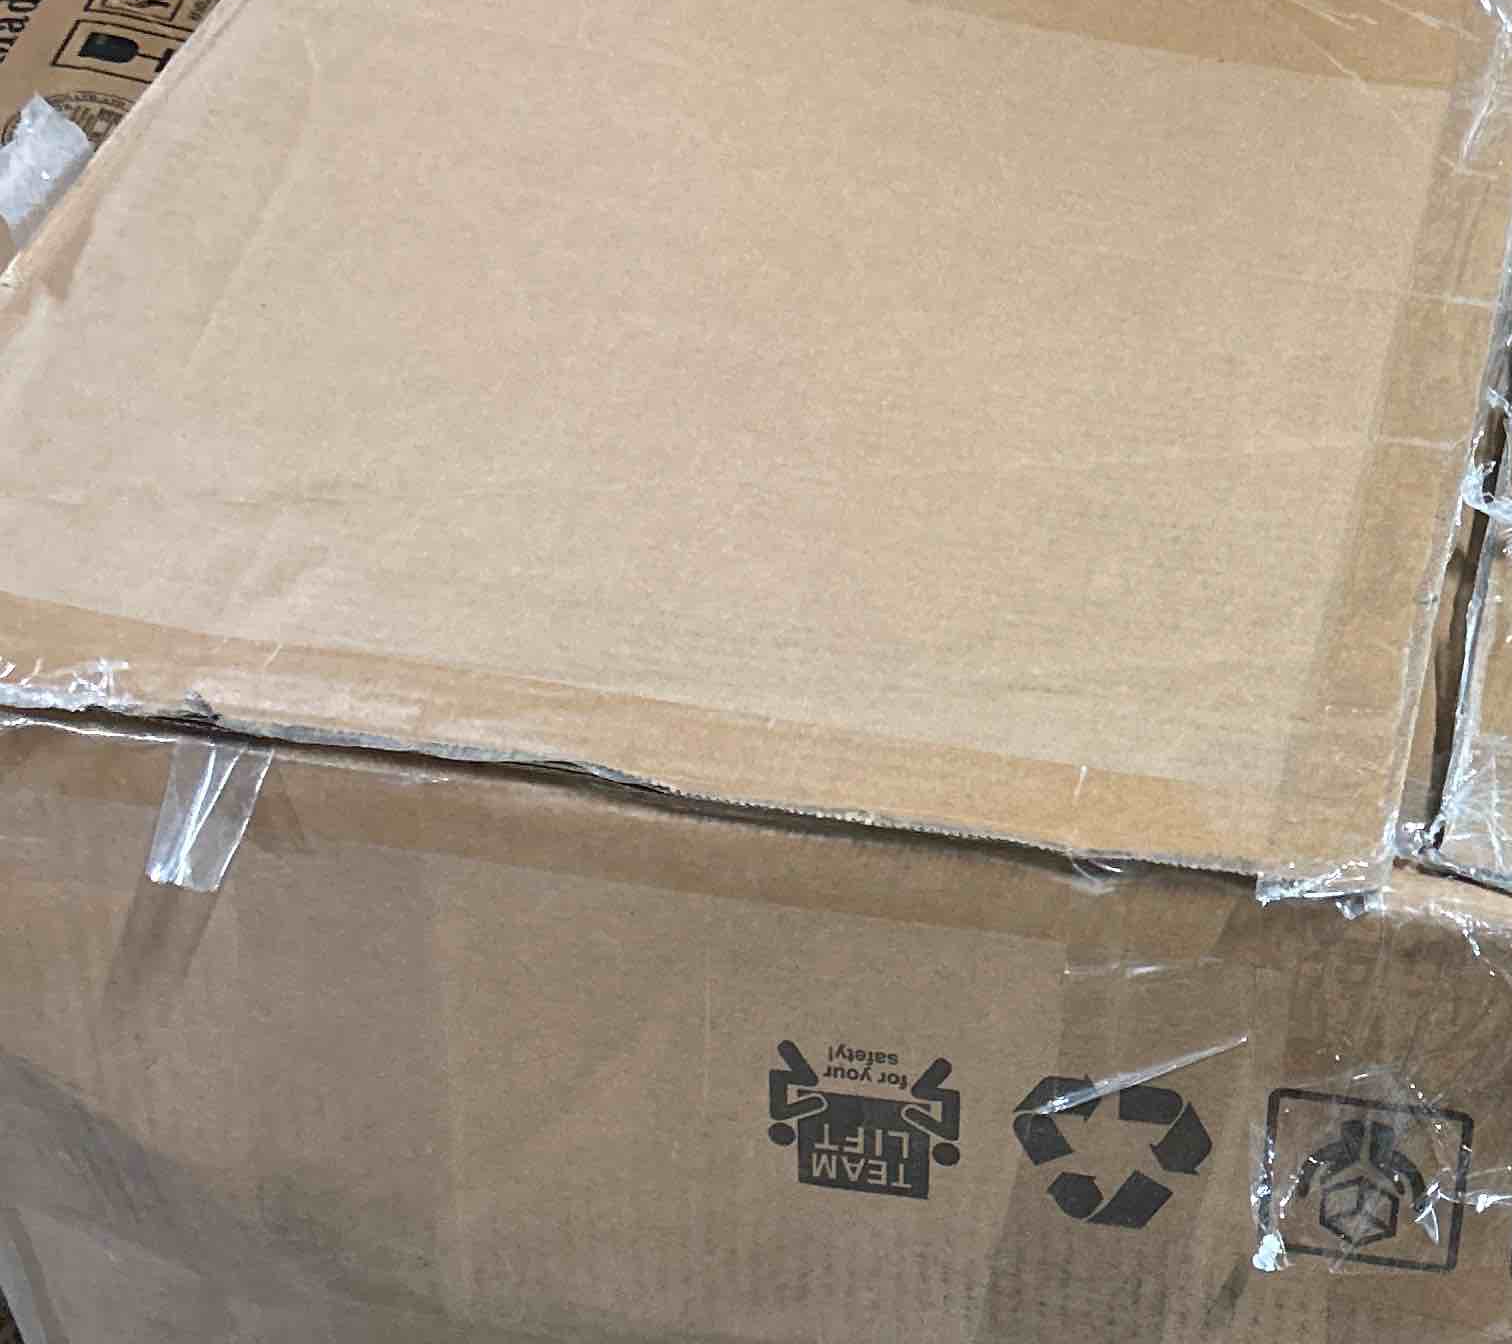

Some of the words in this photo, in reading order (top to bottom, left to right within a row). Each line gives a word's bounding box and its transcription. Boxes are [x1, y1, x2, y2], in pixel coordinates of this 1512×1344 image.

[828, 1042, 899, 1067] safety!
[822, 1065, 873, 1084] your
[877, 1071, 908, 1091] for
[813, 1122, 911, 1160] LIFT
[811, 1152, 913, 1189] TEAM
